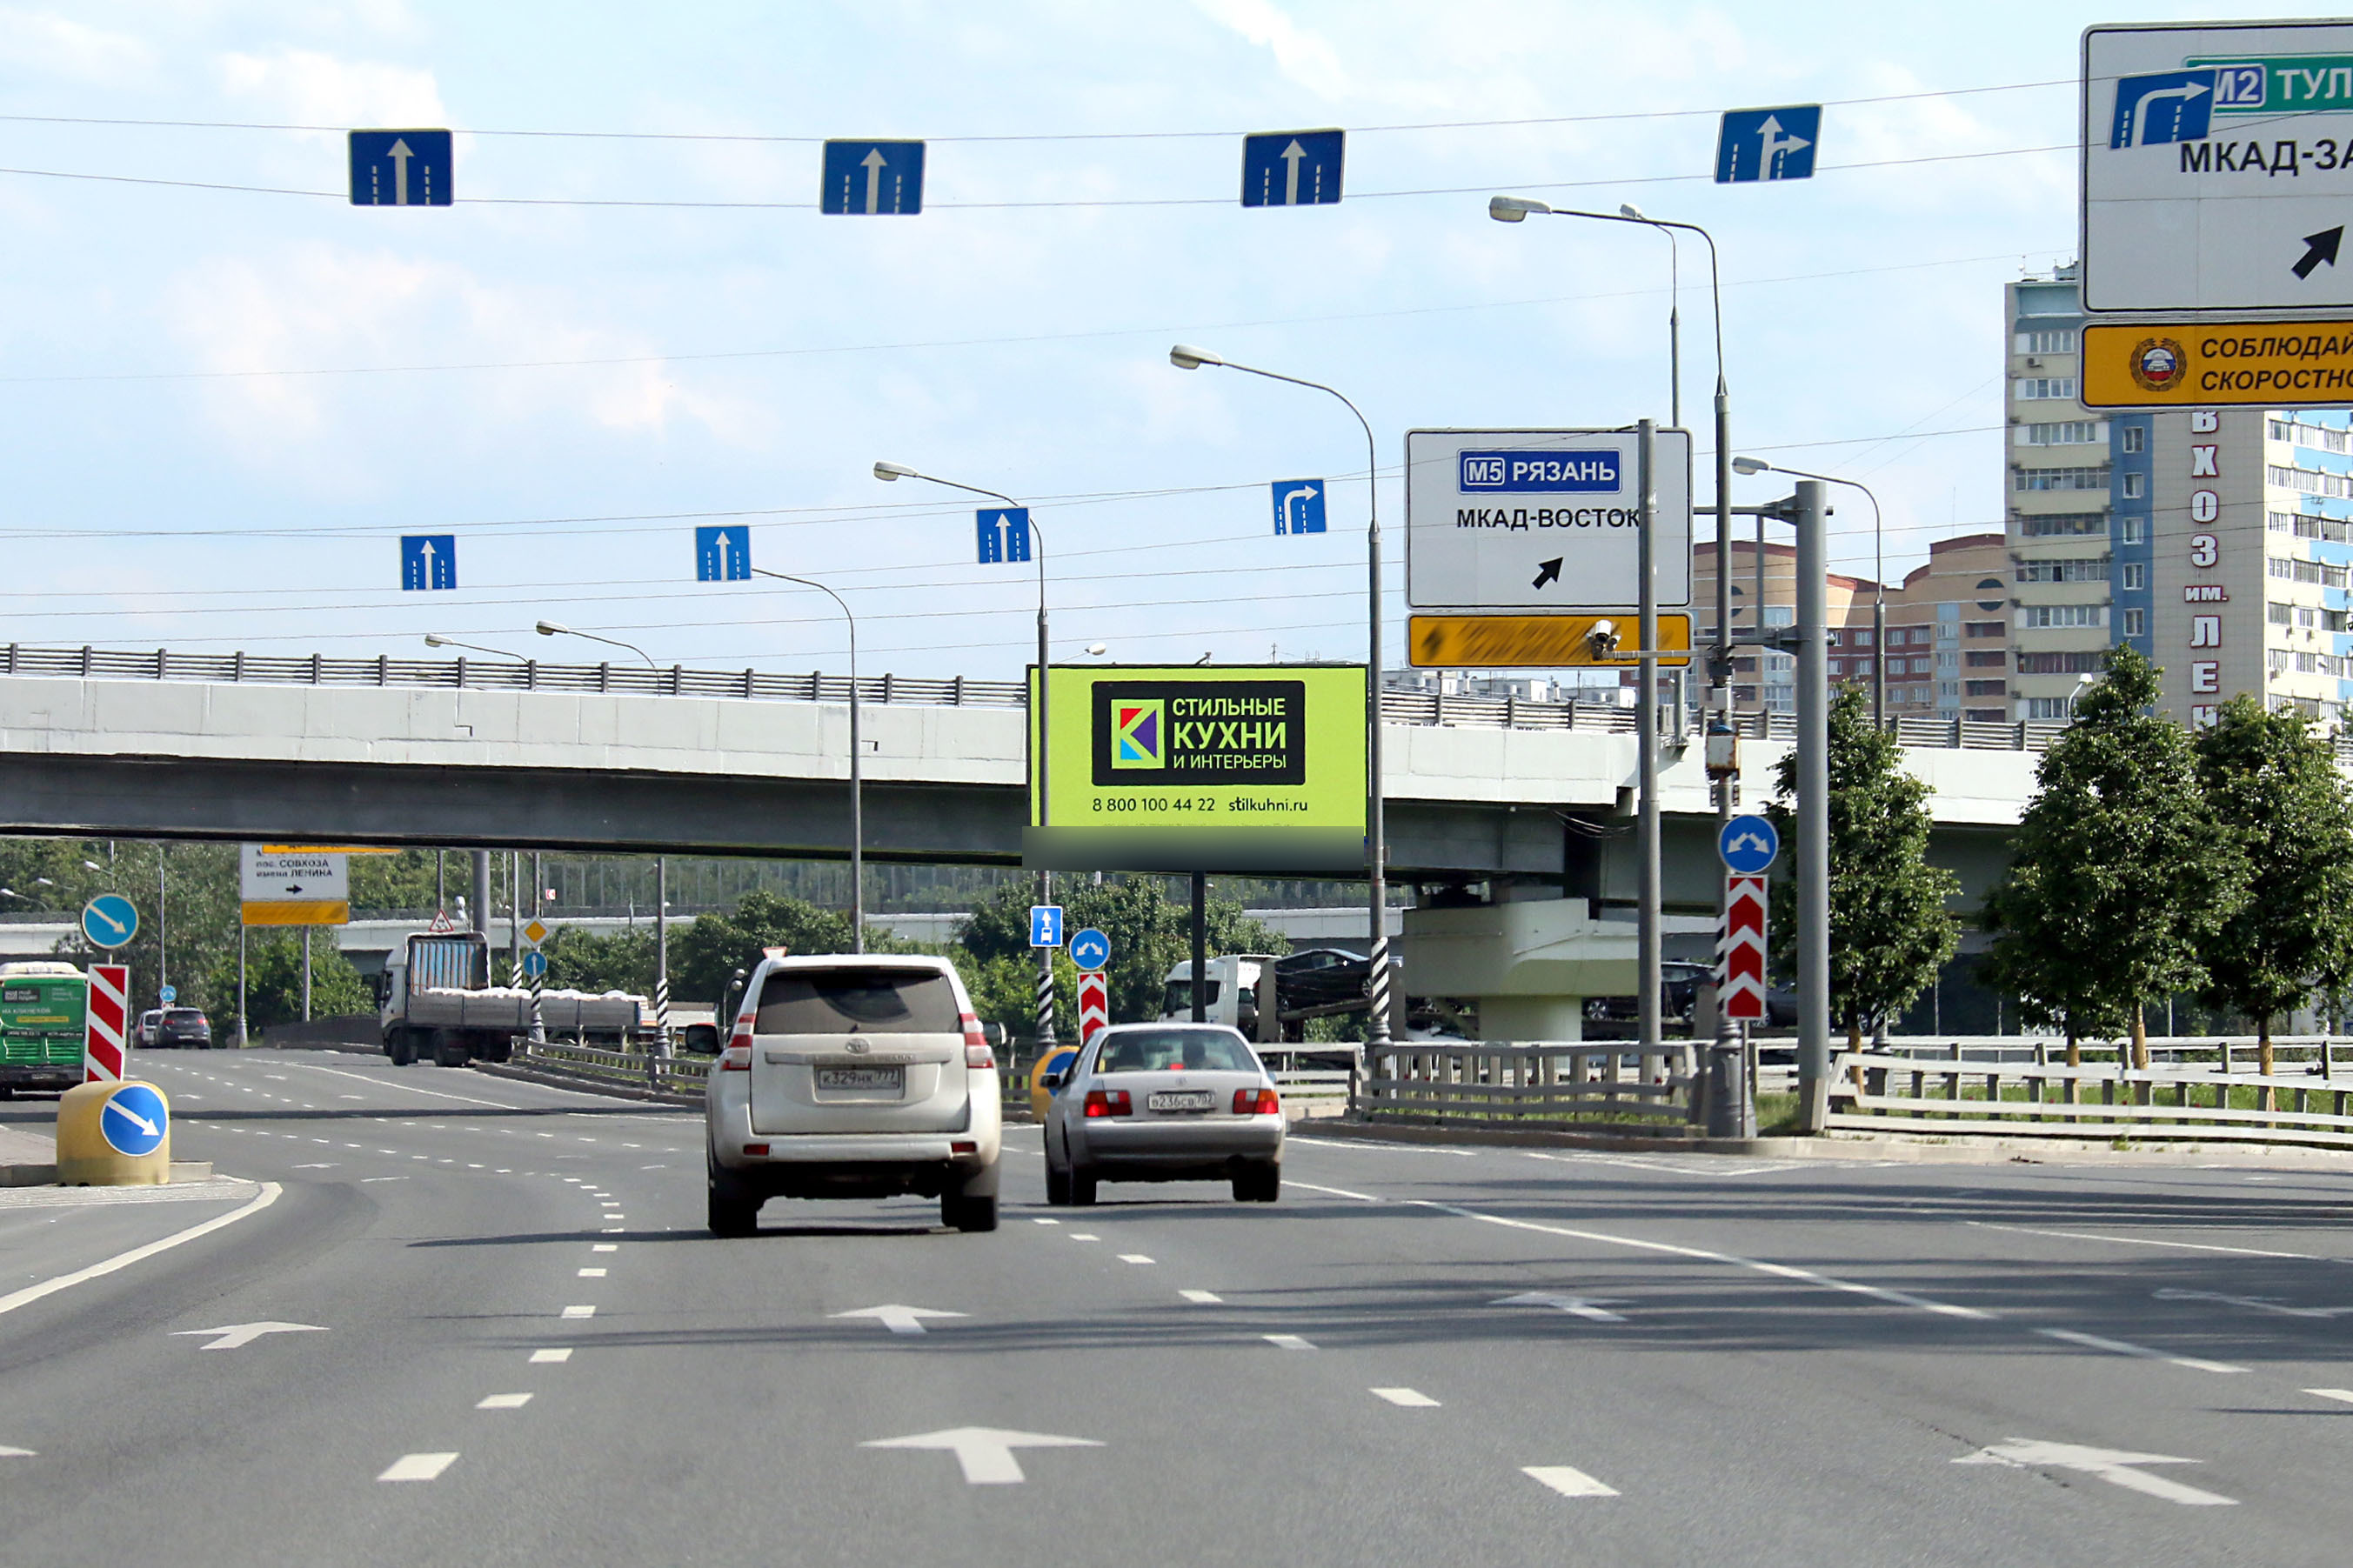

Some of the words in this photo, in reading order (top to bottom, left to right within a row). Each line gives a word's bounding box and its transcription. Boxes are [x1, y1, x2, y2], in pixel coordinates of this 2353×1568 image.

[1468, 462, 1502, 482] М5
[1512, 461, 1616, 482] РЯЗАНЬ
[1456, 508, 1640, 531] МКАД-ВОСТОК
[1172, 697, 1287, 717] СТИЛЬНЫЕ
[1173, 721, 1287, 750] КУХНИ
[1173, 754, 1185, 769] И
[1190, 754, 1287, 770] ИНТЕРЬЕРЫ
[1093, 797, 1102, 812] 8
[1106, 797, 1137, 812] 800
[1141, 797, 1168, 812] 100
[1173, 797, 1193, 812] 44
[1197, 797, 1216, 812] 22
[1228, 797, 1308, 812] stilkuhni.ru
[279, 858, 330, 868] СОВХОЗА
[291, 868, 333, 877] ЛЕНИНА
